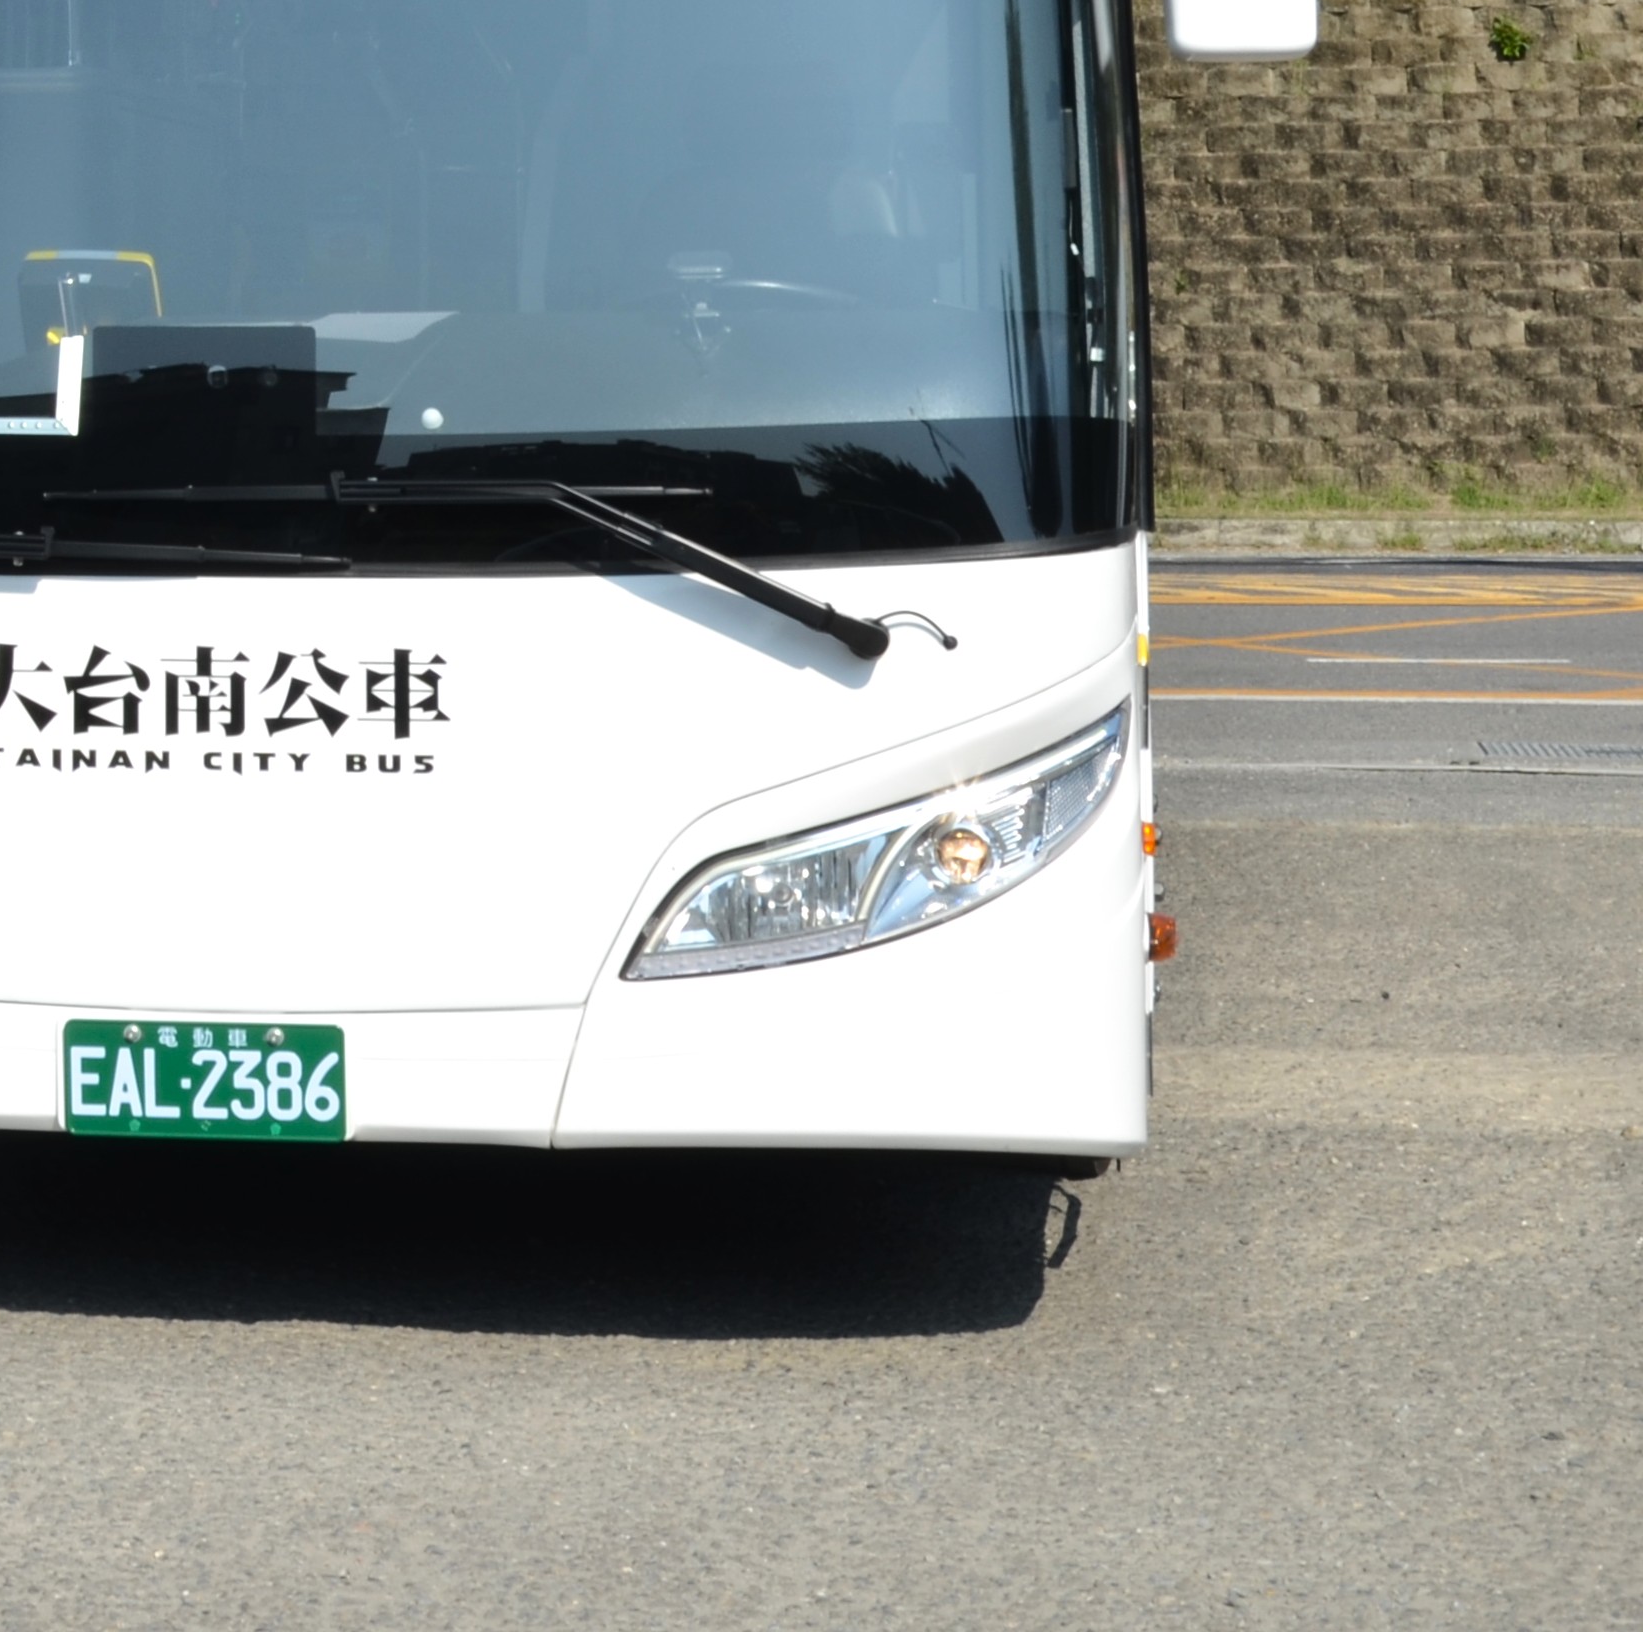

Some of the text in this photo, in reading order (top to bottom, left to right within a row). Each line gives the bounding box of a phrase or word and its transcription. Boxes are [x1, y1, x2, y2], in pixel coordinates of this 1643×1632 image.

[203, 752, 311, 775] CITY
[345, 754, 435, 774] BUS
[157, 1026, 248, 1048] 電動車
